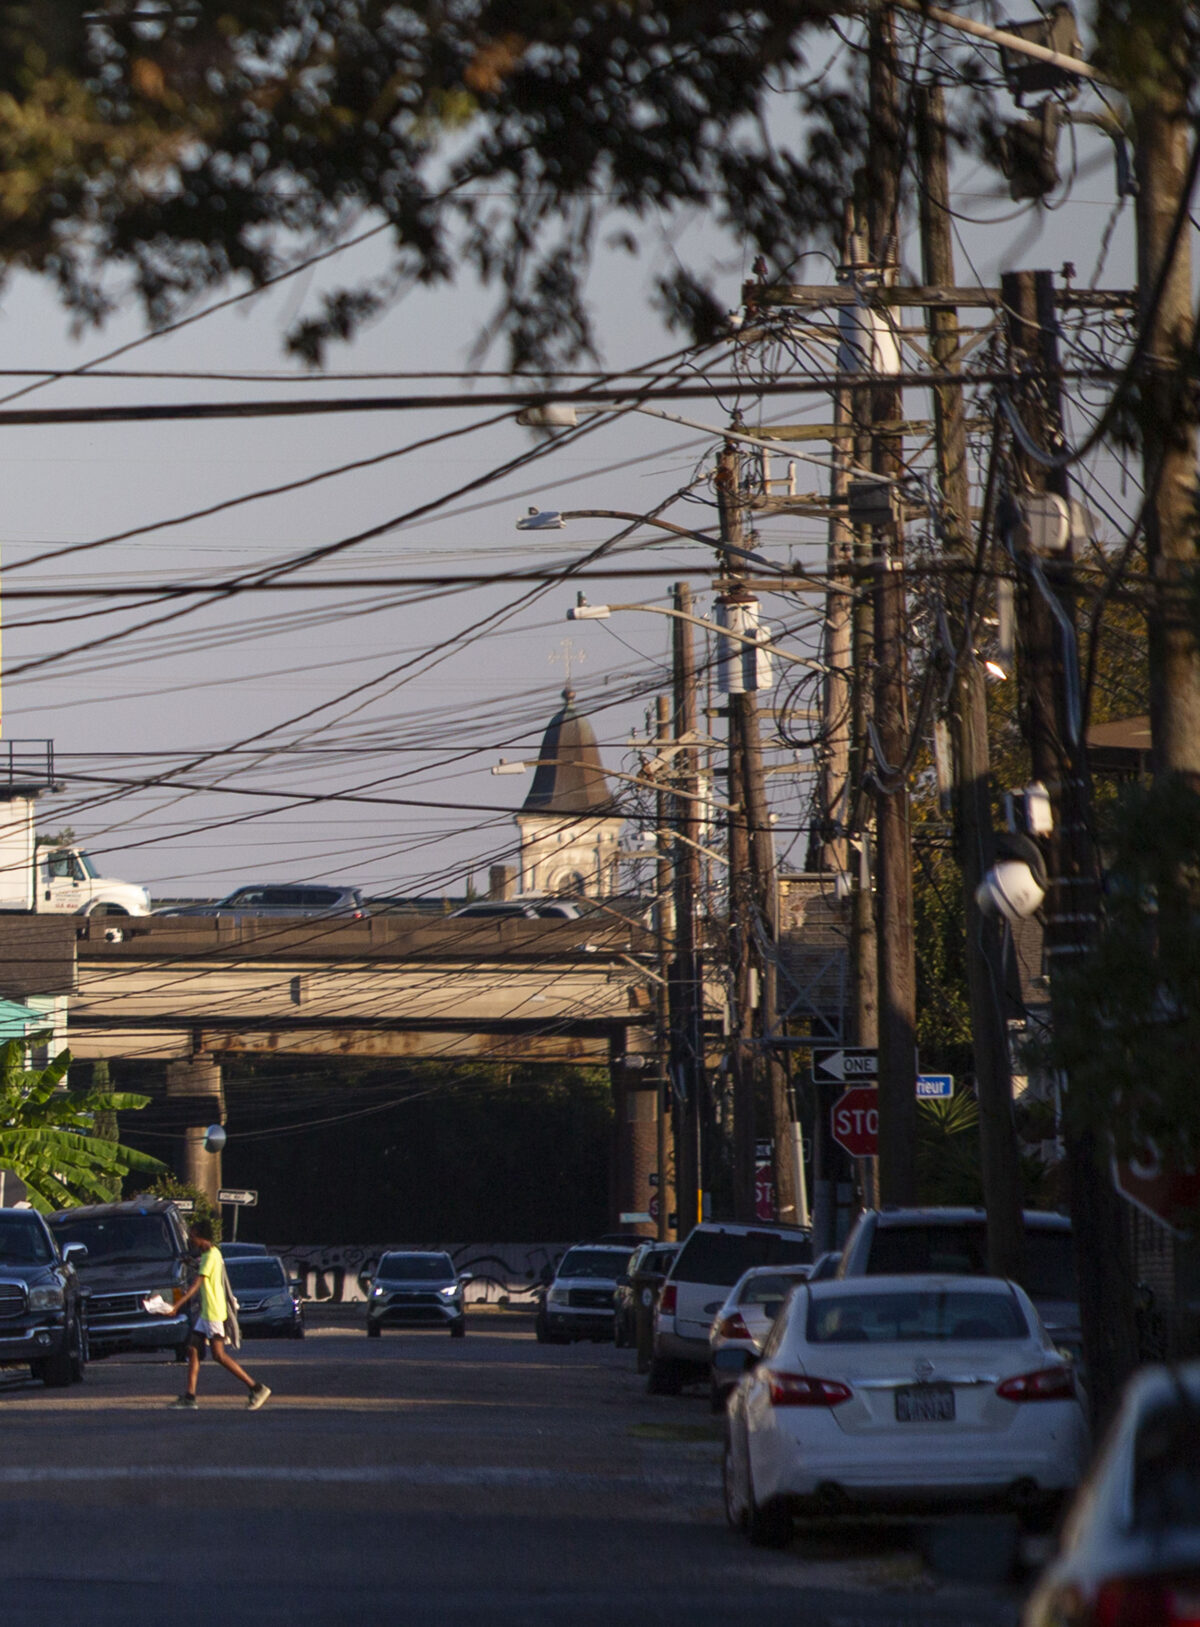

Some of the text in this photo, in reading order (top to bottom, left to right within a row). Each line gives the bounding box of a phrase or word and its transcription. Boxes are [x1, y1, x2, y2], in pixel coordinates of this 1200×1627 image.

[843, 1058, 873, 1072] ONE
[916, 1078, 946, 1095] rieur
[836, 1109, 879, 1135] STO
[756, 1181, 773, 1203] ST
